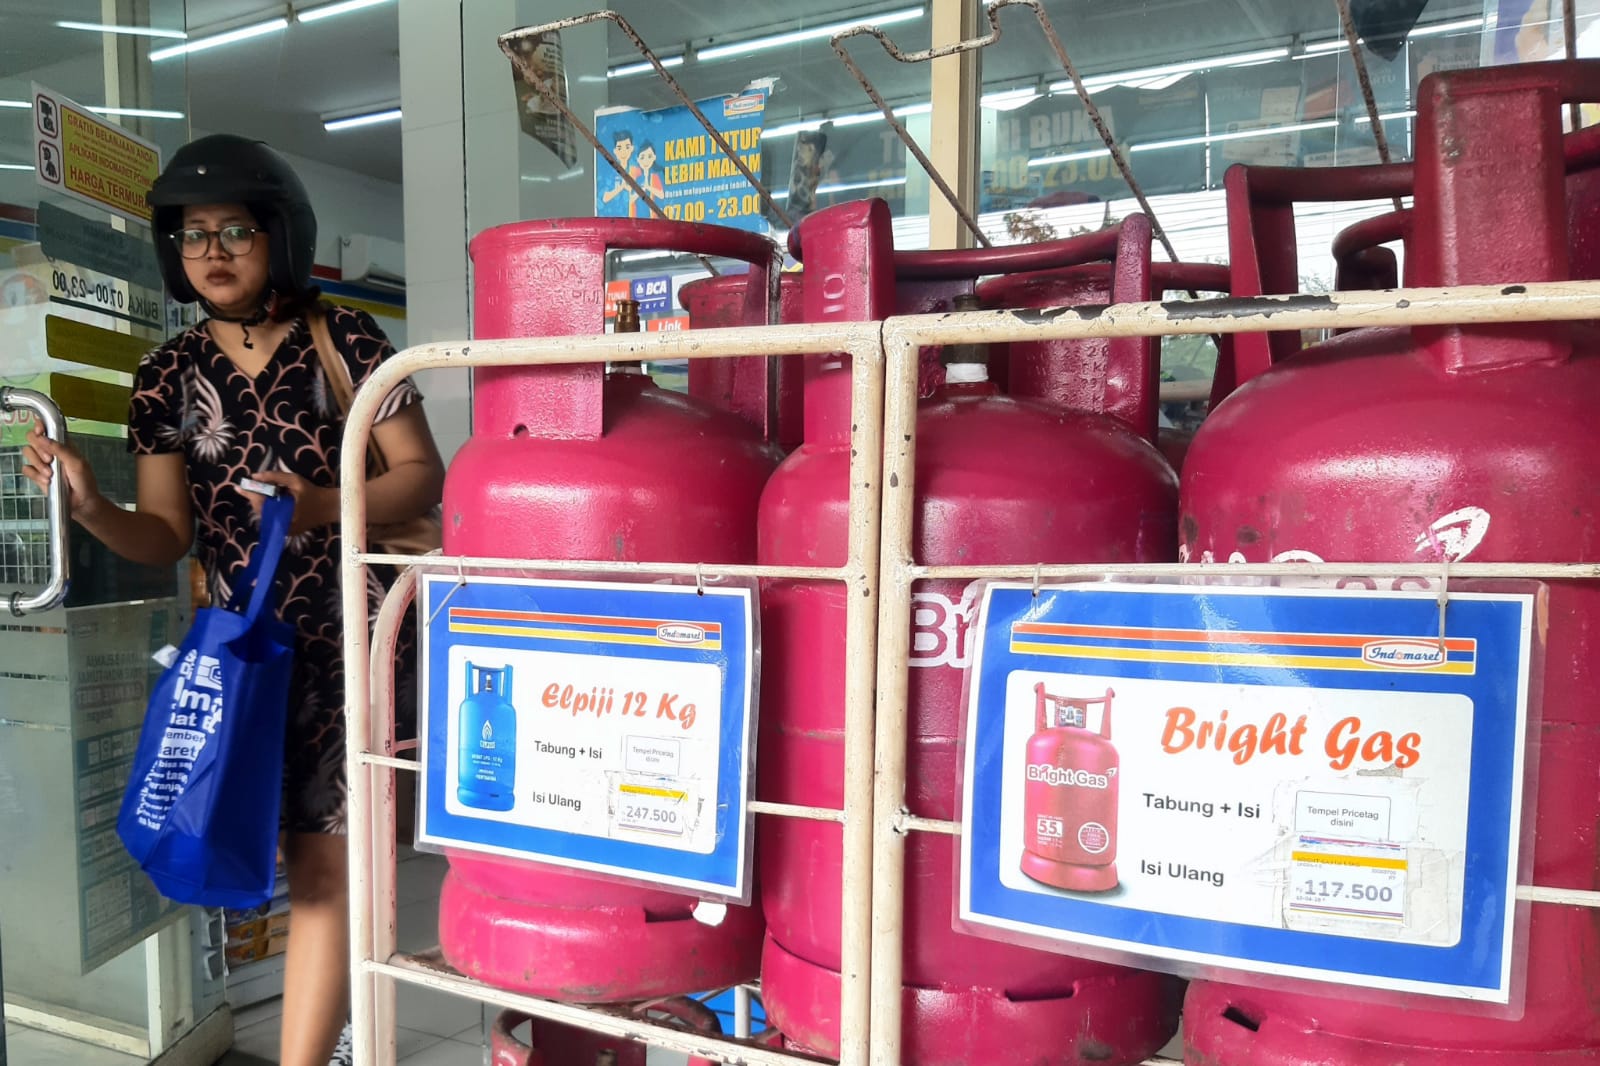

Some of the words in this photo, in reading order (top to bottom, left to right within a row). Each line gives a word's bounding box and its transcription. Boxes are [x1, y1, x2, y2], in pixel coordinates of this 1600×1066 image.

[68, 114, 94, 135] GRATIS
[664, 135, 706, 162] KAMI
[708, 127, 762, 155] TUTUP
[664, 161, 705, 185] LEBIH
[707, 153, 761, 179] MALAM
[70, 164, 105, 193] HARGA
[107, 181, 151, 211] TERMUR
[663, 200, 705, 223] 07.00
[717, 192, 761, 219] 23.00
[646, 280, 667, 296] BCA
[658, 320, 682, 333] Link
[660, 627, 701, 641] Indomaret
[1368, 646, 1441, 663] Indomaret
[541, 682, 614, 718] Elpiji
[622, 691, 648, 717] 12
[656, 692, 697, 730] Kg
[534, 740, 576, 758] Tabung
[579, 748, 586, 756] +
[589, 746, 603, 759] Isi
[1161, 706, 1308, 766] Bright
[1324, 716, 1422, 771] Gas
[1028, 765, 1074, 786] Bright
[1076, 771, 1107, 788] Gas
[532, 791, 547, 804] Isi
[548, 793, 582, 812] Ulang
[1142, 793, 1215, 818] Tabung
[1220, 803, 1232, 814] +
[1237, 802, 1261, 819] Isi
[626, 804, 677, 824] 247.500
[1307, 805, 1339, 819] Tempel
[1341, 808, 1379, 821] Pricetag
[1330, 817, 1354, 828] disini
[1141, 859, 1162, 877] Isi
[1168, 862, 1226, 887] Ulang
[1304, 879, 1394, 903] 117.500
